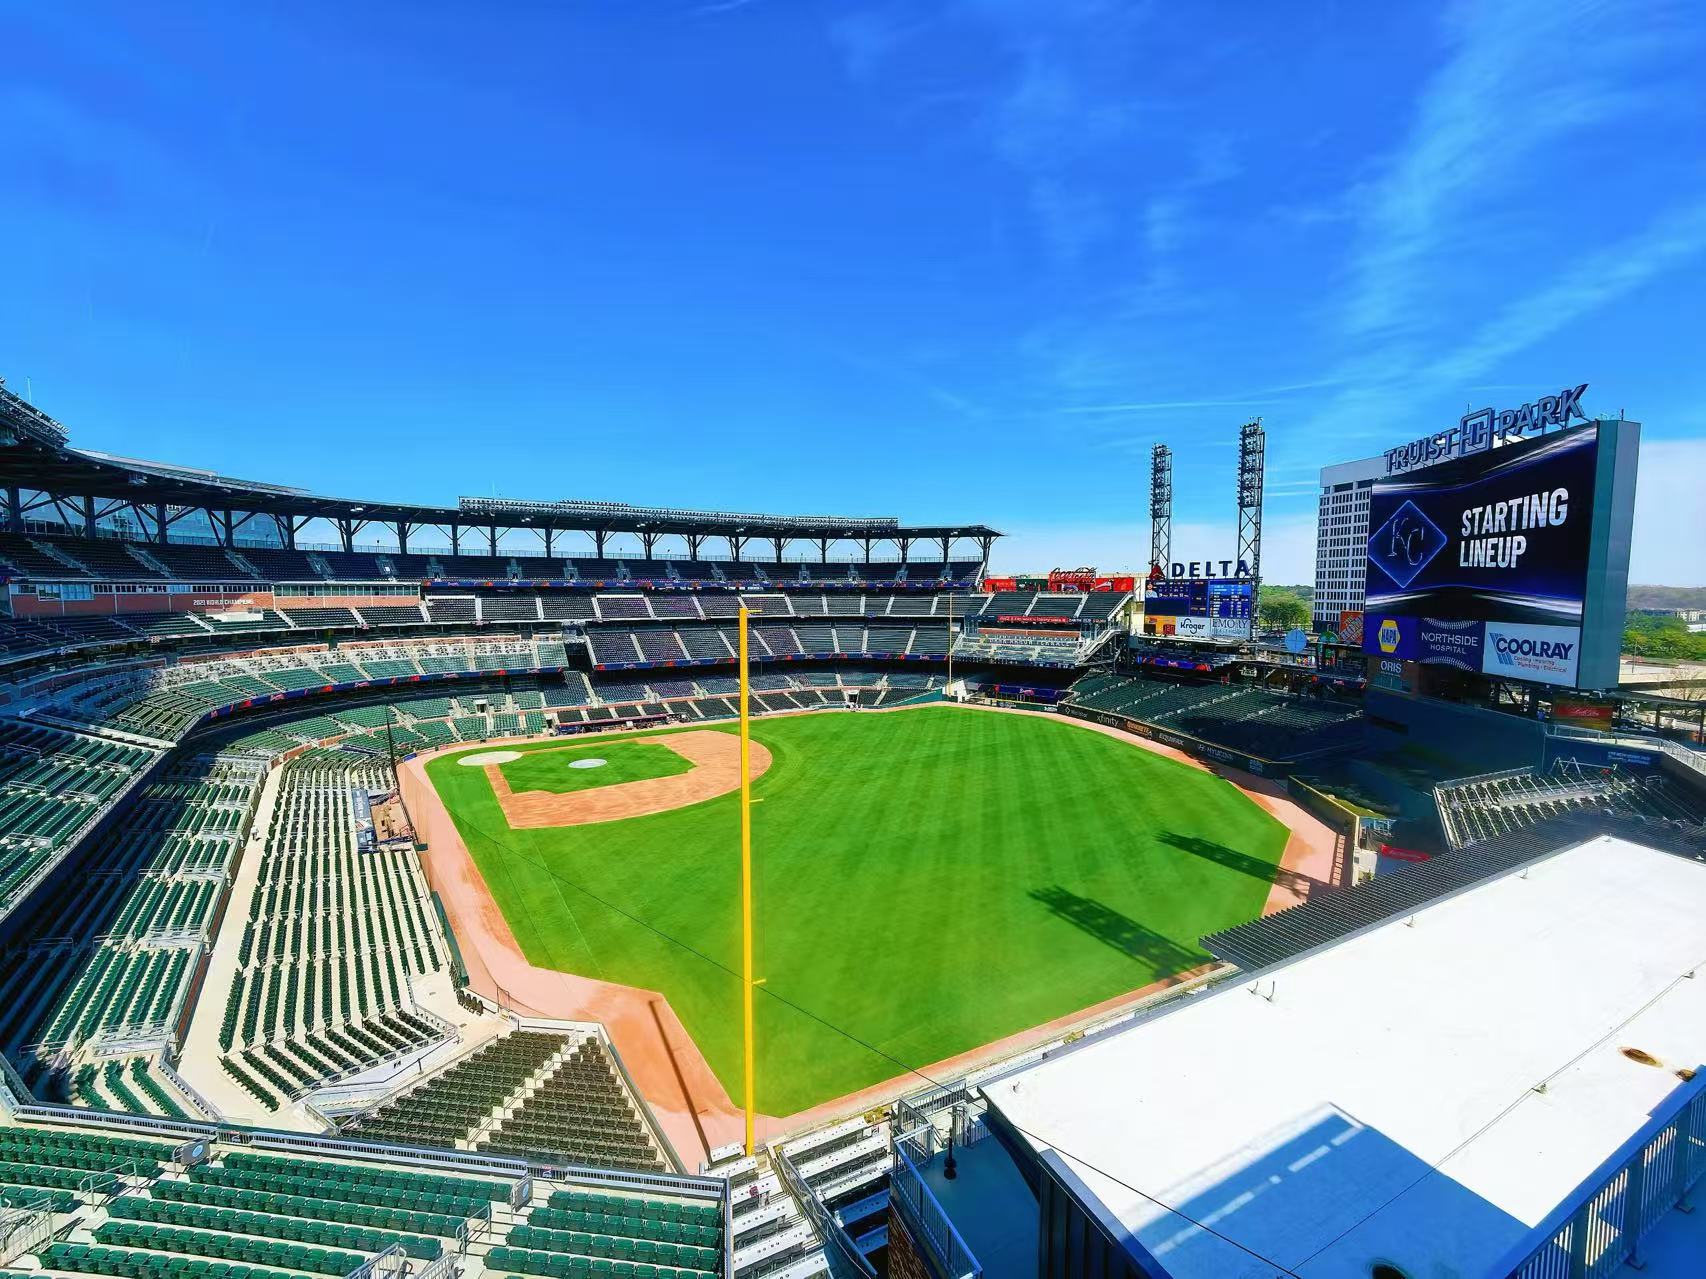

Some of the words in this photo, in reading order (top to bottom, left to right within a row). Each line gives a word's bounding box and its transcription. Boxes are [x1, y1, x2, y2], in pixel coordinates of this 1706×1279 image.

[1383, 427, 1460, 472] TRUIST
[1498, 383, 1589, 439] PARK
[1461, 487, 1569, 537] STARTING
[1459, 535, 1527, 568] LINEUP
[1171, 559, 1250, 578] DELTA
[1180, 618, 1206, 635] Kroger
[1421, 632, 1479, 647] NORTHSIDE
[1496, 637, 1574, 660] COOLRAY
[1430, 644, 1467, 655] HOSPITAL
[1380, 660, 1402, 674] ORIS
[1096, 713, 1119, 727] xfinity
